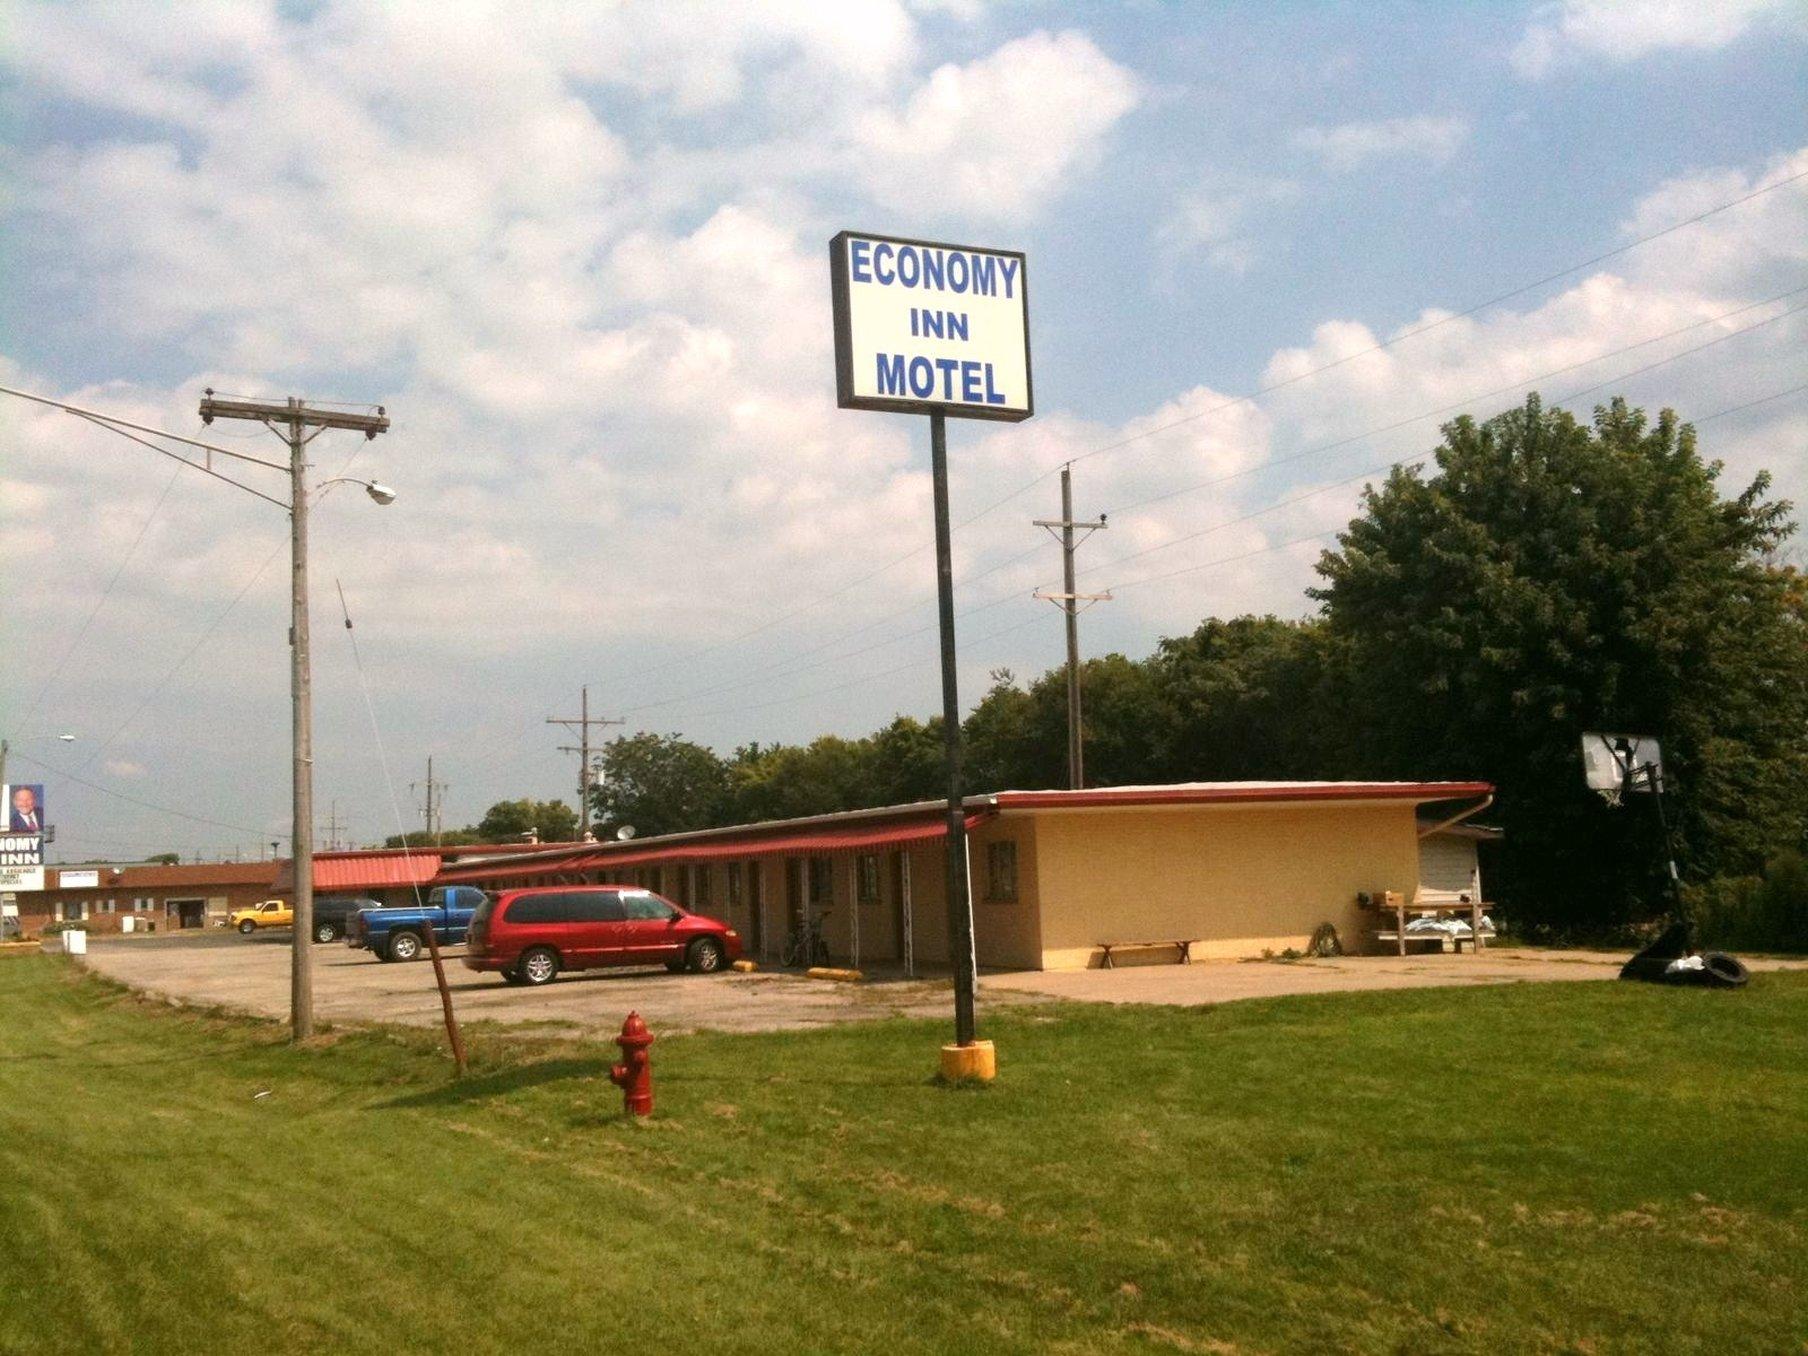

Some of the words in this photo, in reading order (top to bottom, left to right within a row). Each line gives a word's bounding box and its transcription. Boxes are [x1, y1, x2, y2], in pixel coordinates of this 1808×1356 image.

[851, 240, 1019, 299] ECONOMY
[910, 307, 969, 342] INN
[876, 352, 1006, 405] MOTEL
[1, 853, 40, 865] INN
